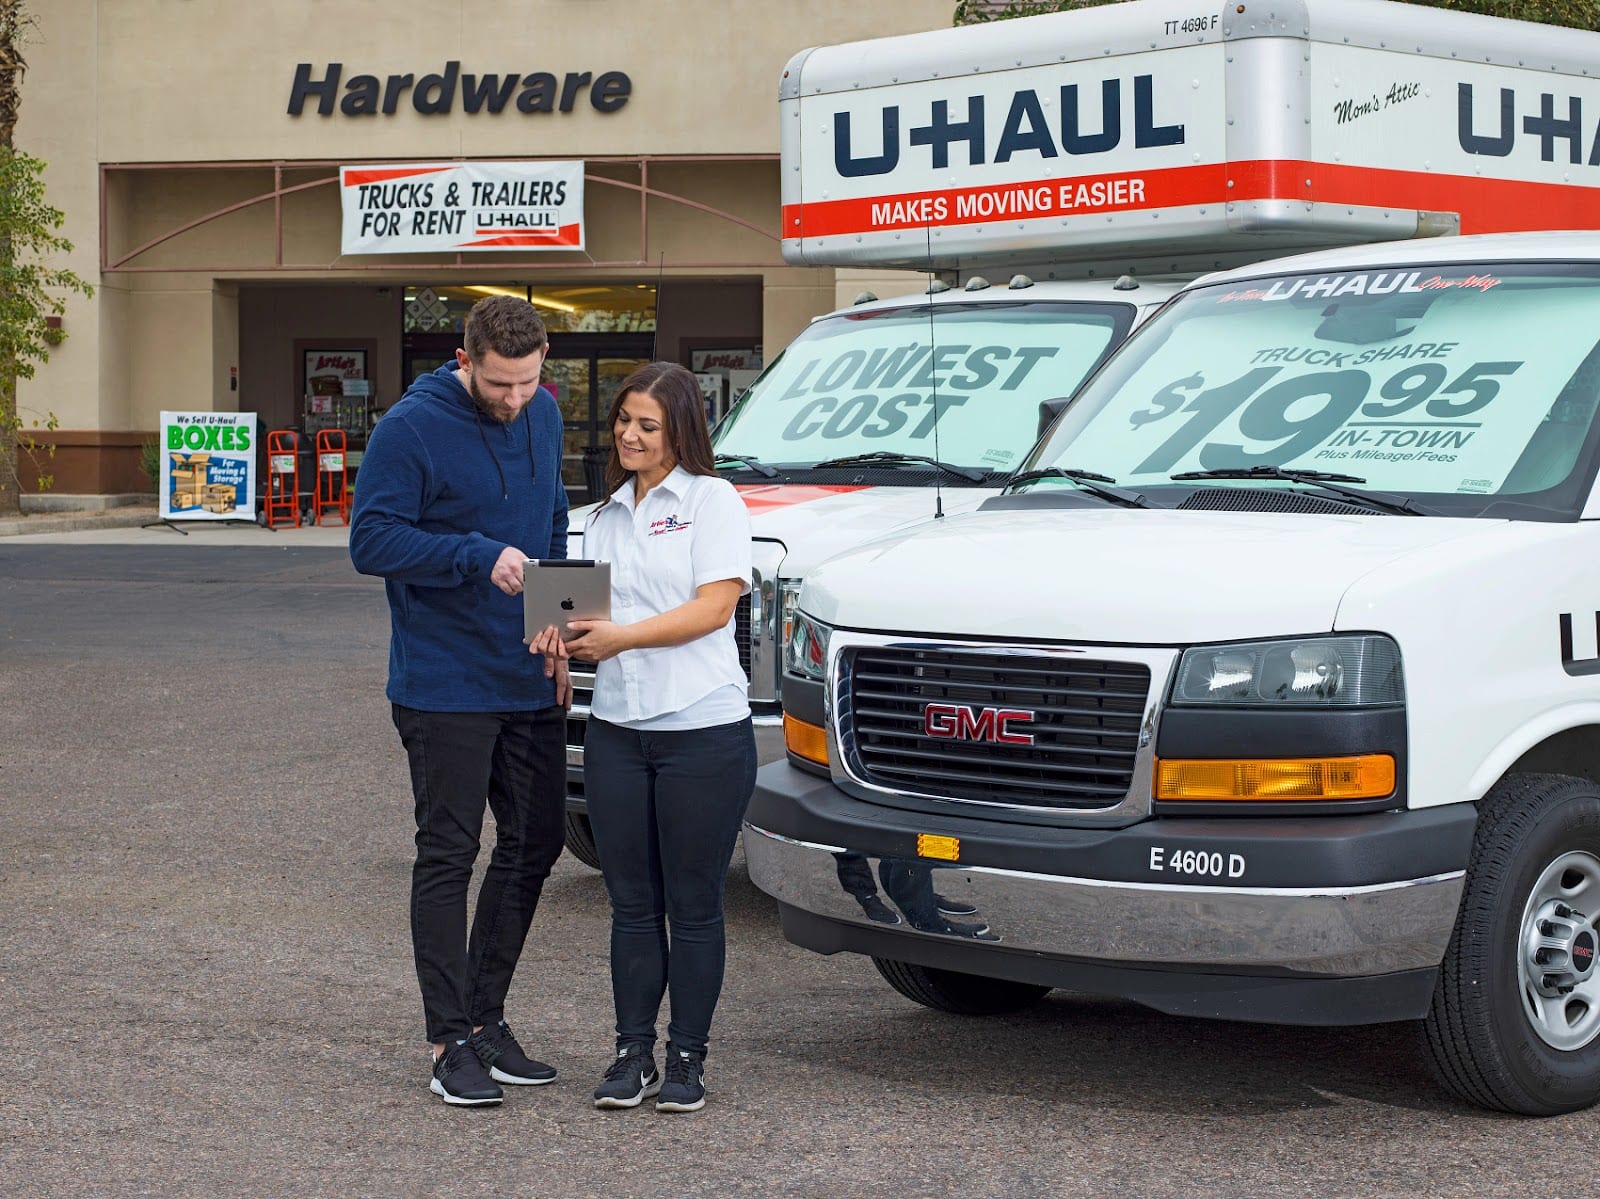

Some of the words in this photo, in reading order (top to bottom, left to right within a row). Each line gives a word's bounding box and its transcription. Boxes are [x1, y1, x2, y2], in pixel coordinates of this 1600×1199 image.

[1164, 21, 1179, 35] TT
[1181, 16, 1208, 33] 4696
[1210, 14, 1219, 29] F
[287, 61, 632, 116] Hardware
[1334, 94, 1380, 125] Mom's
[1384, 81, 1421, 109] Attic
[834, 74, 1185, 178] U-HAUL
[1458, 82, 1600, 166] U-H
[358, 182, 434, 210] TRUCKS
[444, 182, 460, 207] &
[472, 180, 567, 207] TRAILERS
[871, 197, 948, 226] MAKES
[956, 186, 1052, 218] MOVING
[1060, 179, 1146, 209] EASIER
[360, 211, 401, 237] FOR
[411, 209, 466, 236] RENT
[477, 212, 556, 227] U-HAUL
[1261, 272, 1423, 301] U-HAUL
[1250, 346, 1353, 368] TRUCK
[1353, 342, 1459, 366] SHARE
[779, 344, 1060, 401] LOWEST
[177, 416, 190, 424] We
[191, 415, 207, 424] Sell
[208, 415, 237, 424] U-Haul
[781, 393, 970, 441] COST
[167, 425, 250, 451] BOXES
[1328, 430, 1475, 450] IN-TOWN
[222, 458, 236, 467] For
[1315, 449, 1348, 460] Plus
[1352, 450, 1458, 463] Mileage/Fees
[210, 466, 239, 477] Moving
[238, 466, 246, 475] &
[213, 475, 244, 484] Storage
[925, 703, 1035, 746] GMC
[1150, 847, 1164, 870] E
[1170, 849, 1223, 877] 4600
[1229, 854, 1246, 878] D
